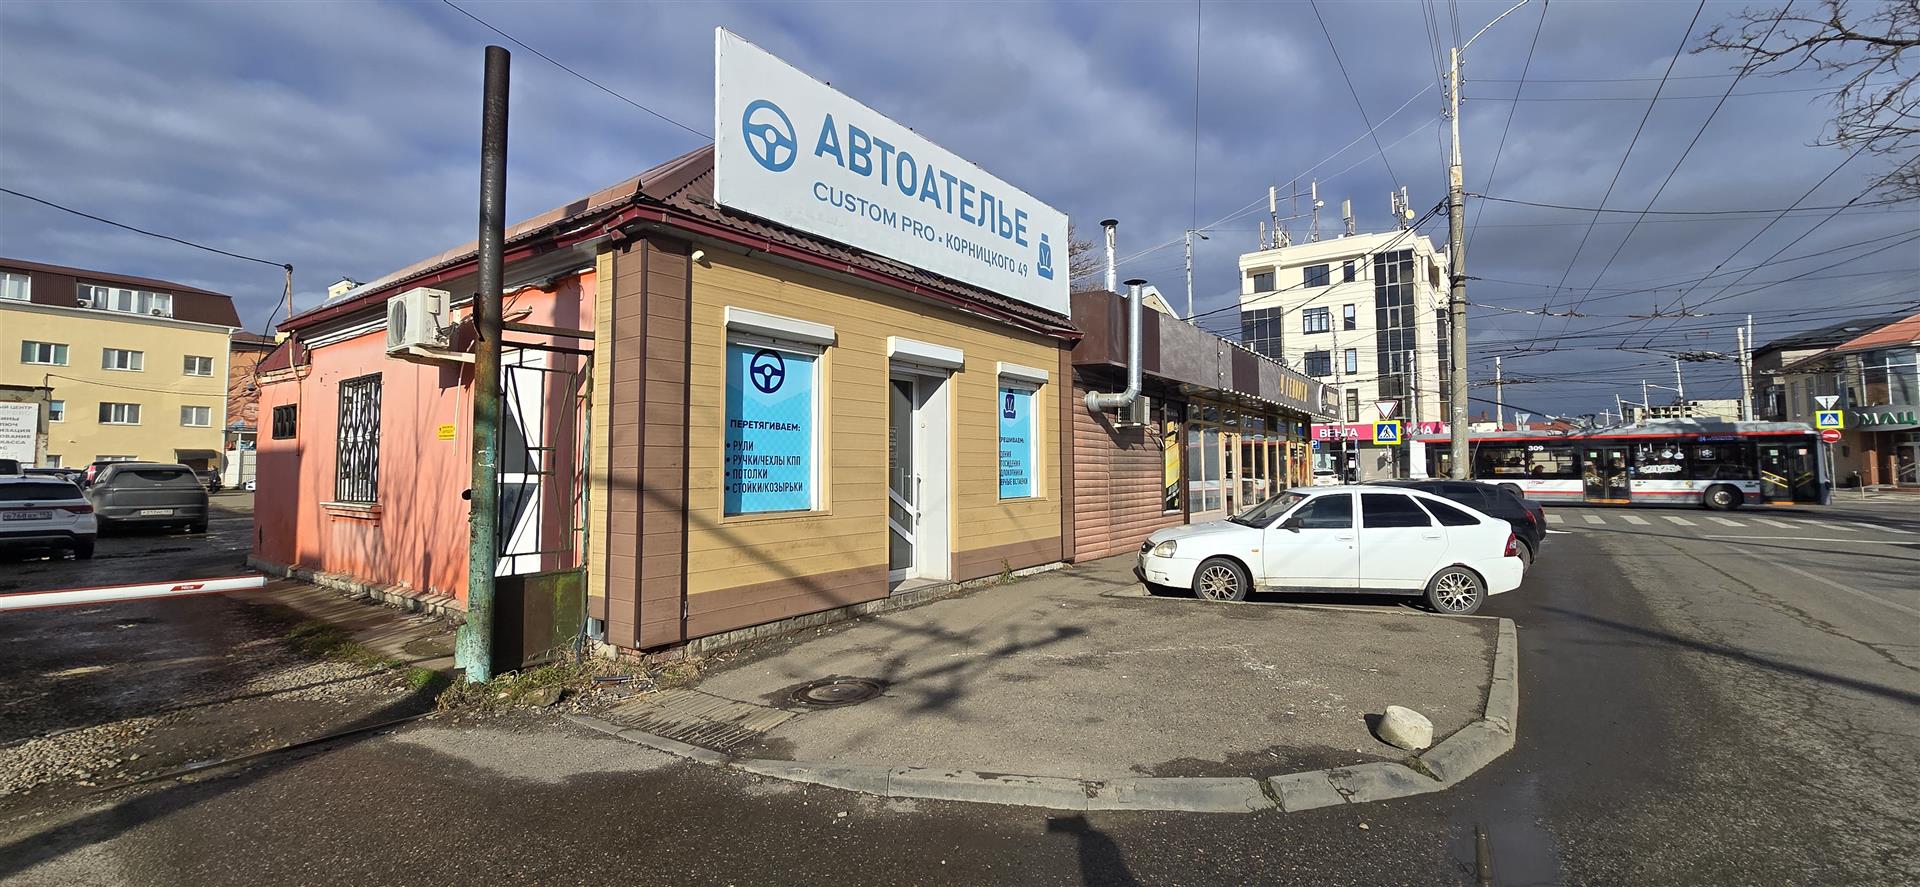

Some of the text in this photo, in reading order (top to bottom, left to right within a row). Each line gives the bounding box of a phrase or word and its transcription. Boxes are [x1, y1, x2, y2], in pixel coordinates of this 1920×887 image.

[814, 113, 1029, 248] АВТОАТЕЛЬЕ
[813, 181, 935, 244] CUSTOM PRO
[946, 232, 1028, 278] КОРНИЦКОГО 49
[730, 419, 801, 432] ПЕРЕТЯГИВАЕМ:
[733, 440, 754, 451] РУЛИ
[733, 454, 801, 466] РУЧКИ/ЧЕХЛЫ КПП
[732, 468, 768, 480] ПОТОЛКИ
[732, 480, 803, 493] СТОЙКИ/КОЗЫРЬКИ
